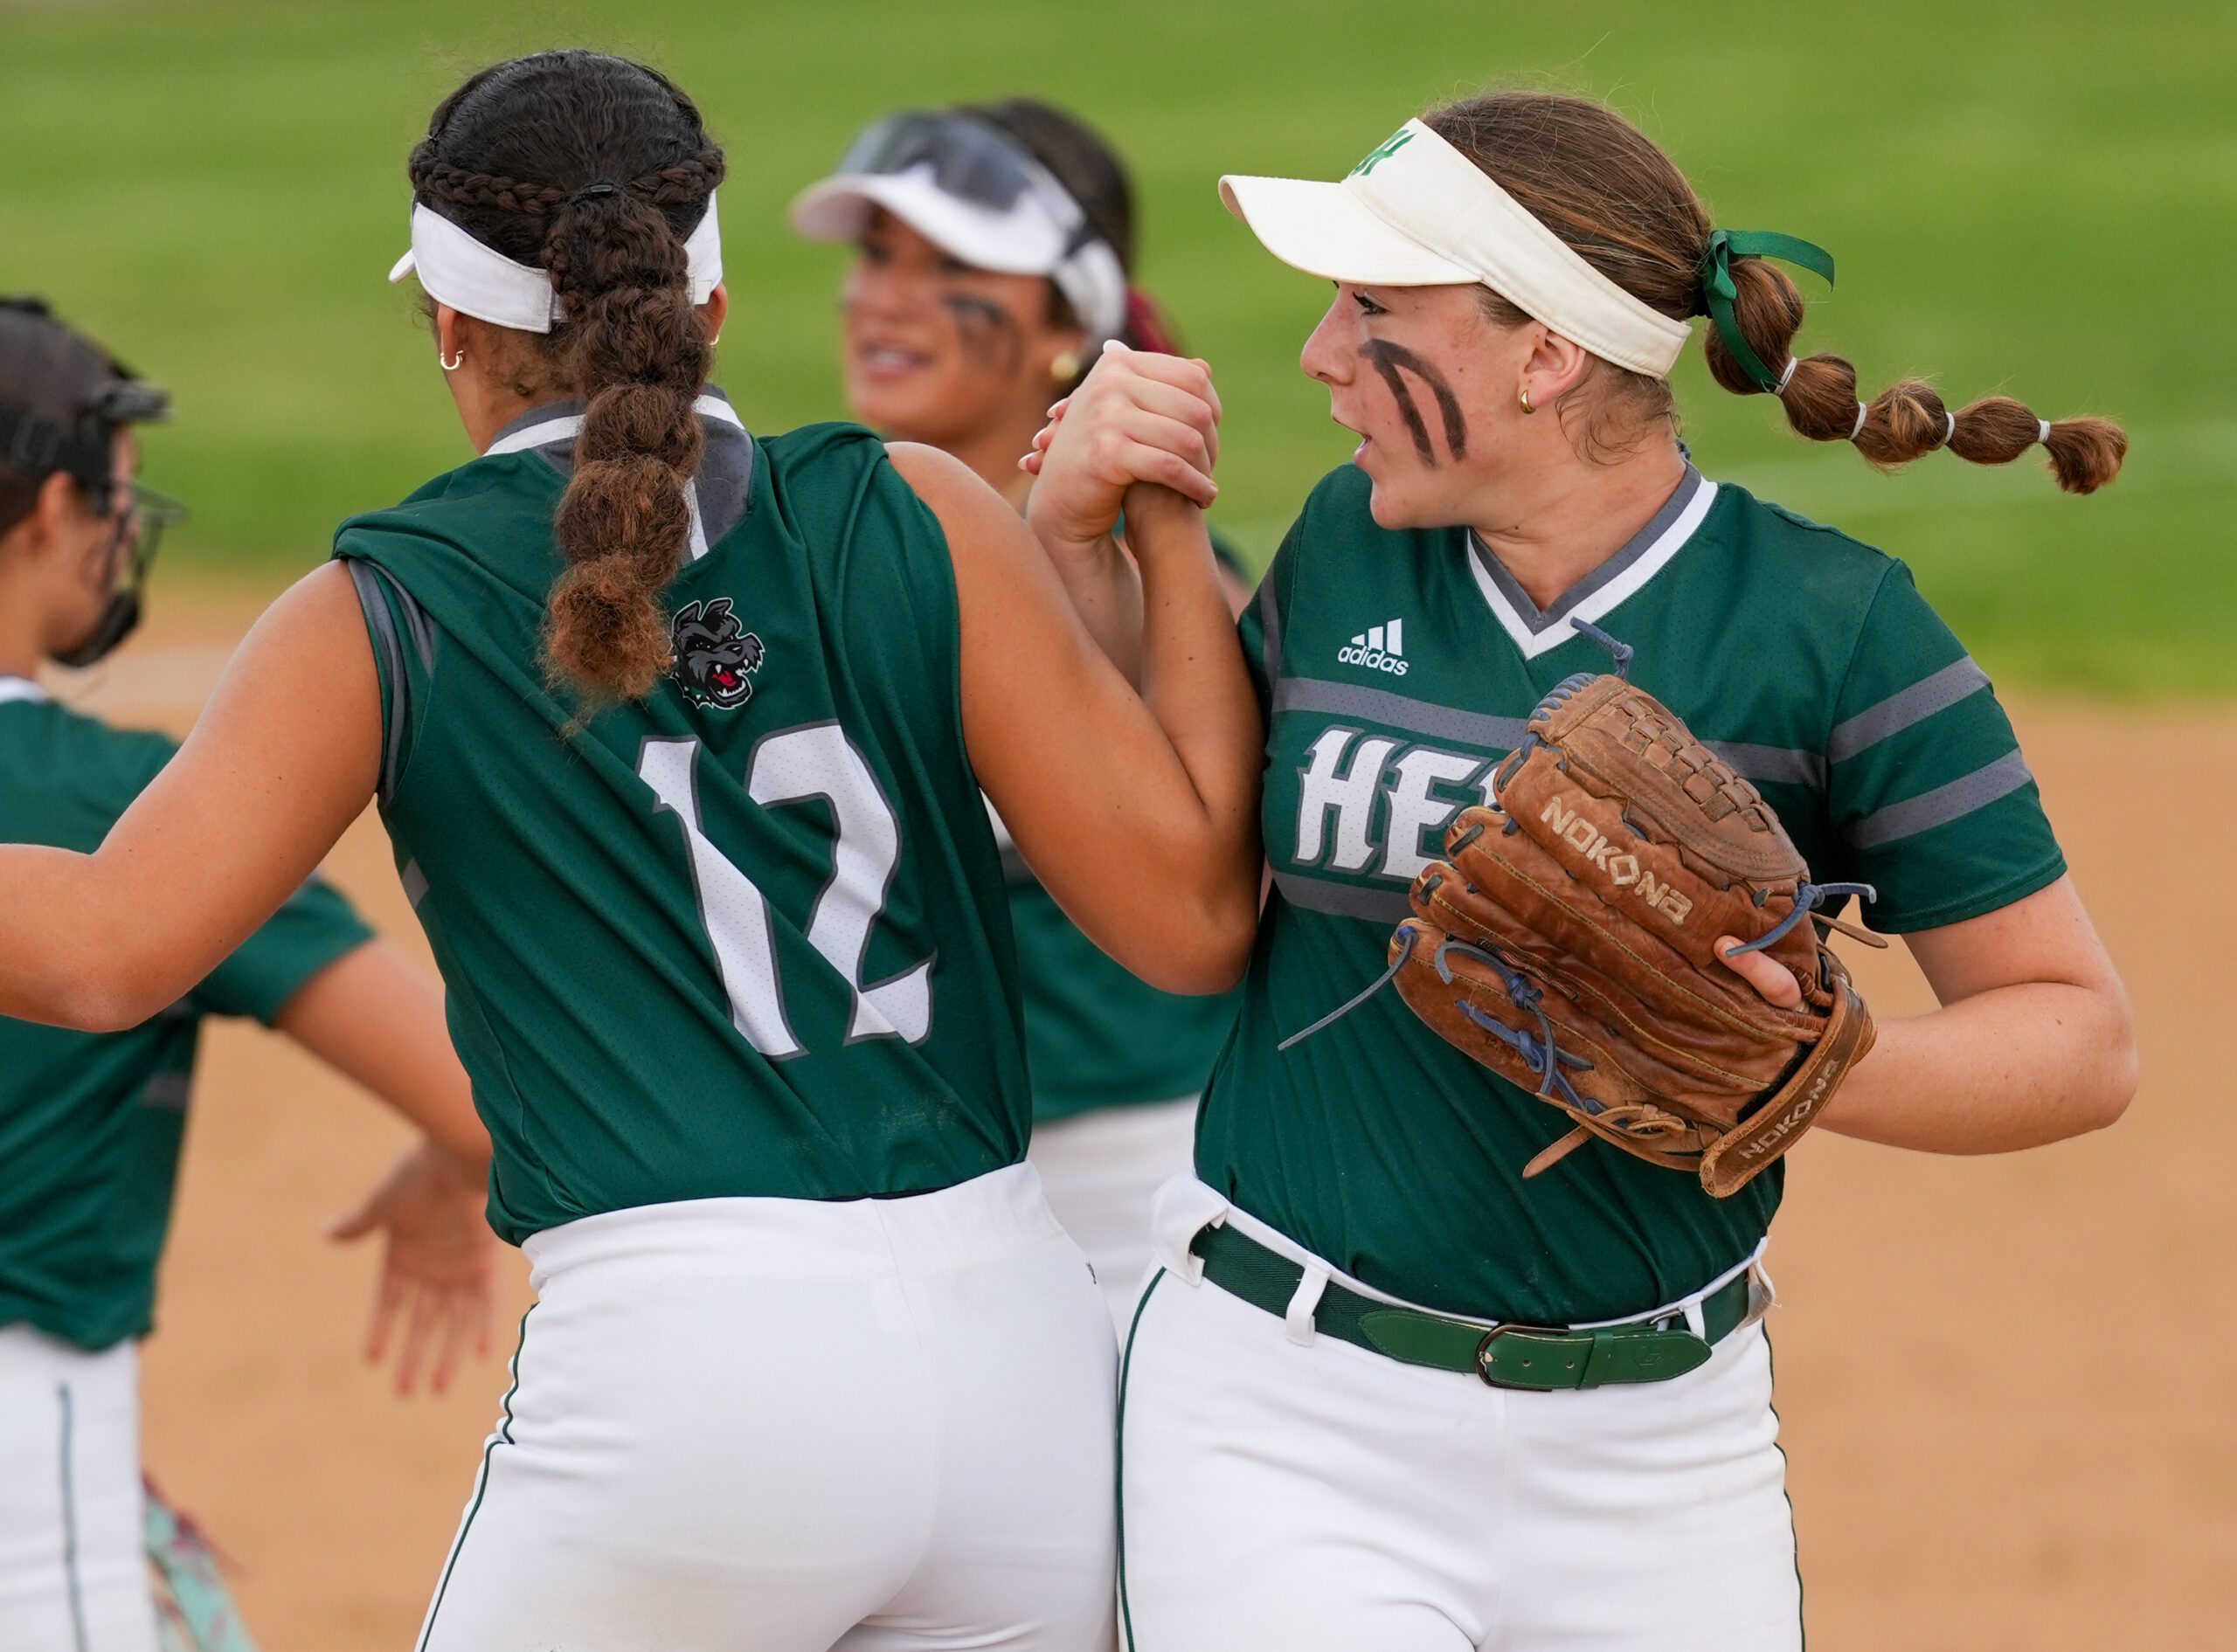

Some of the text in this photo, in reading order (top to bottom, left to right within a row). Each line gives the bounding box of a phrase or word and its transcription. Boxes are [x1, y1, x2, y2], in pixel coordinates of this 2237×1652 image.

[1337, 646, 1409, 676] adidas
[1292, 724, 1500, 881] HE
[635, 719, 937, 1061] 12
